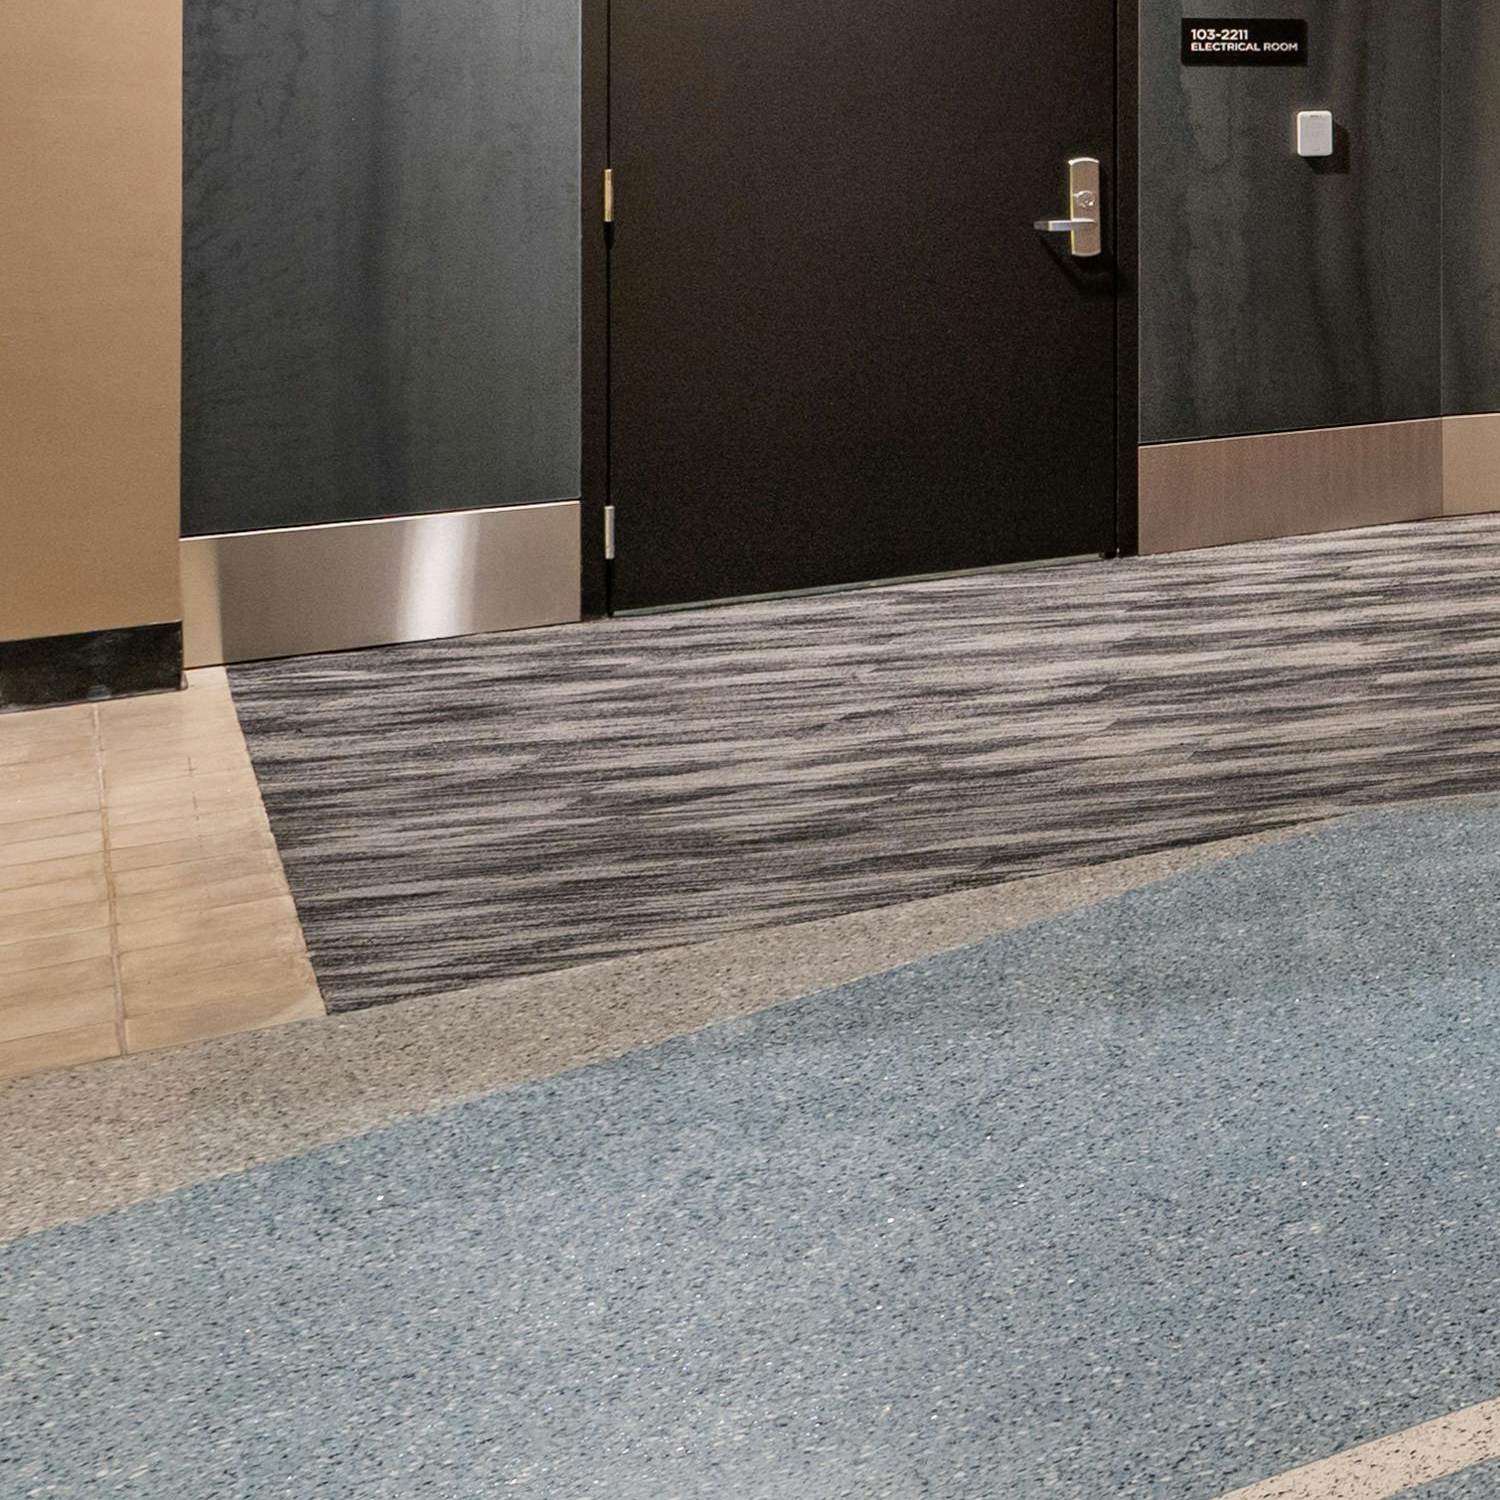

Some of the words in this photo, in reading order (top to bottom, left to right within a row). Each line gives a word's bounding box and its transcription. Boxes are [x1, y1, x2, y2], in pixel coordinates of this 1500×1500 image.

[1190, 29, 1249, 41] 103-2211
[1190, 42, 1261, 52] ELECTRICAL
[1263, 42, 1299, 52] ROOM
